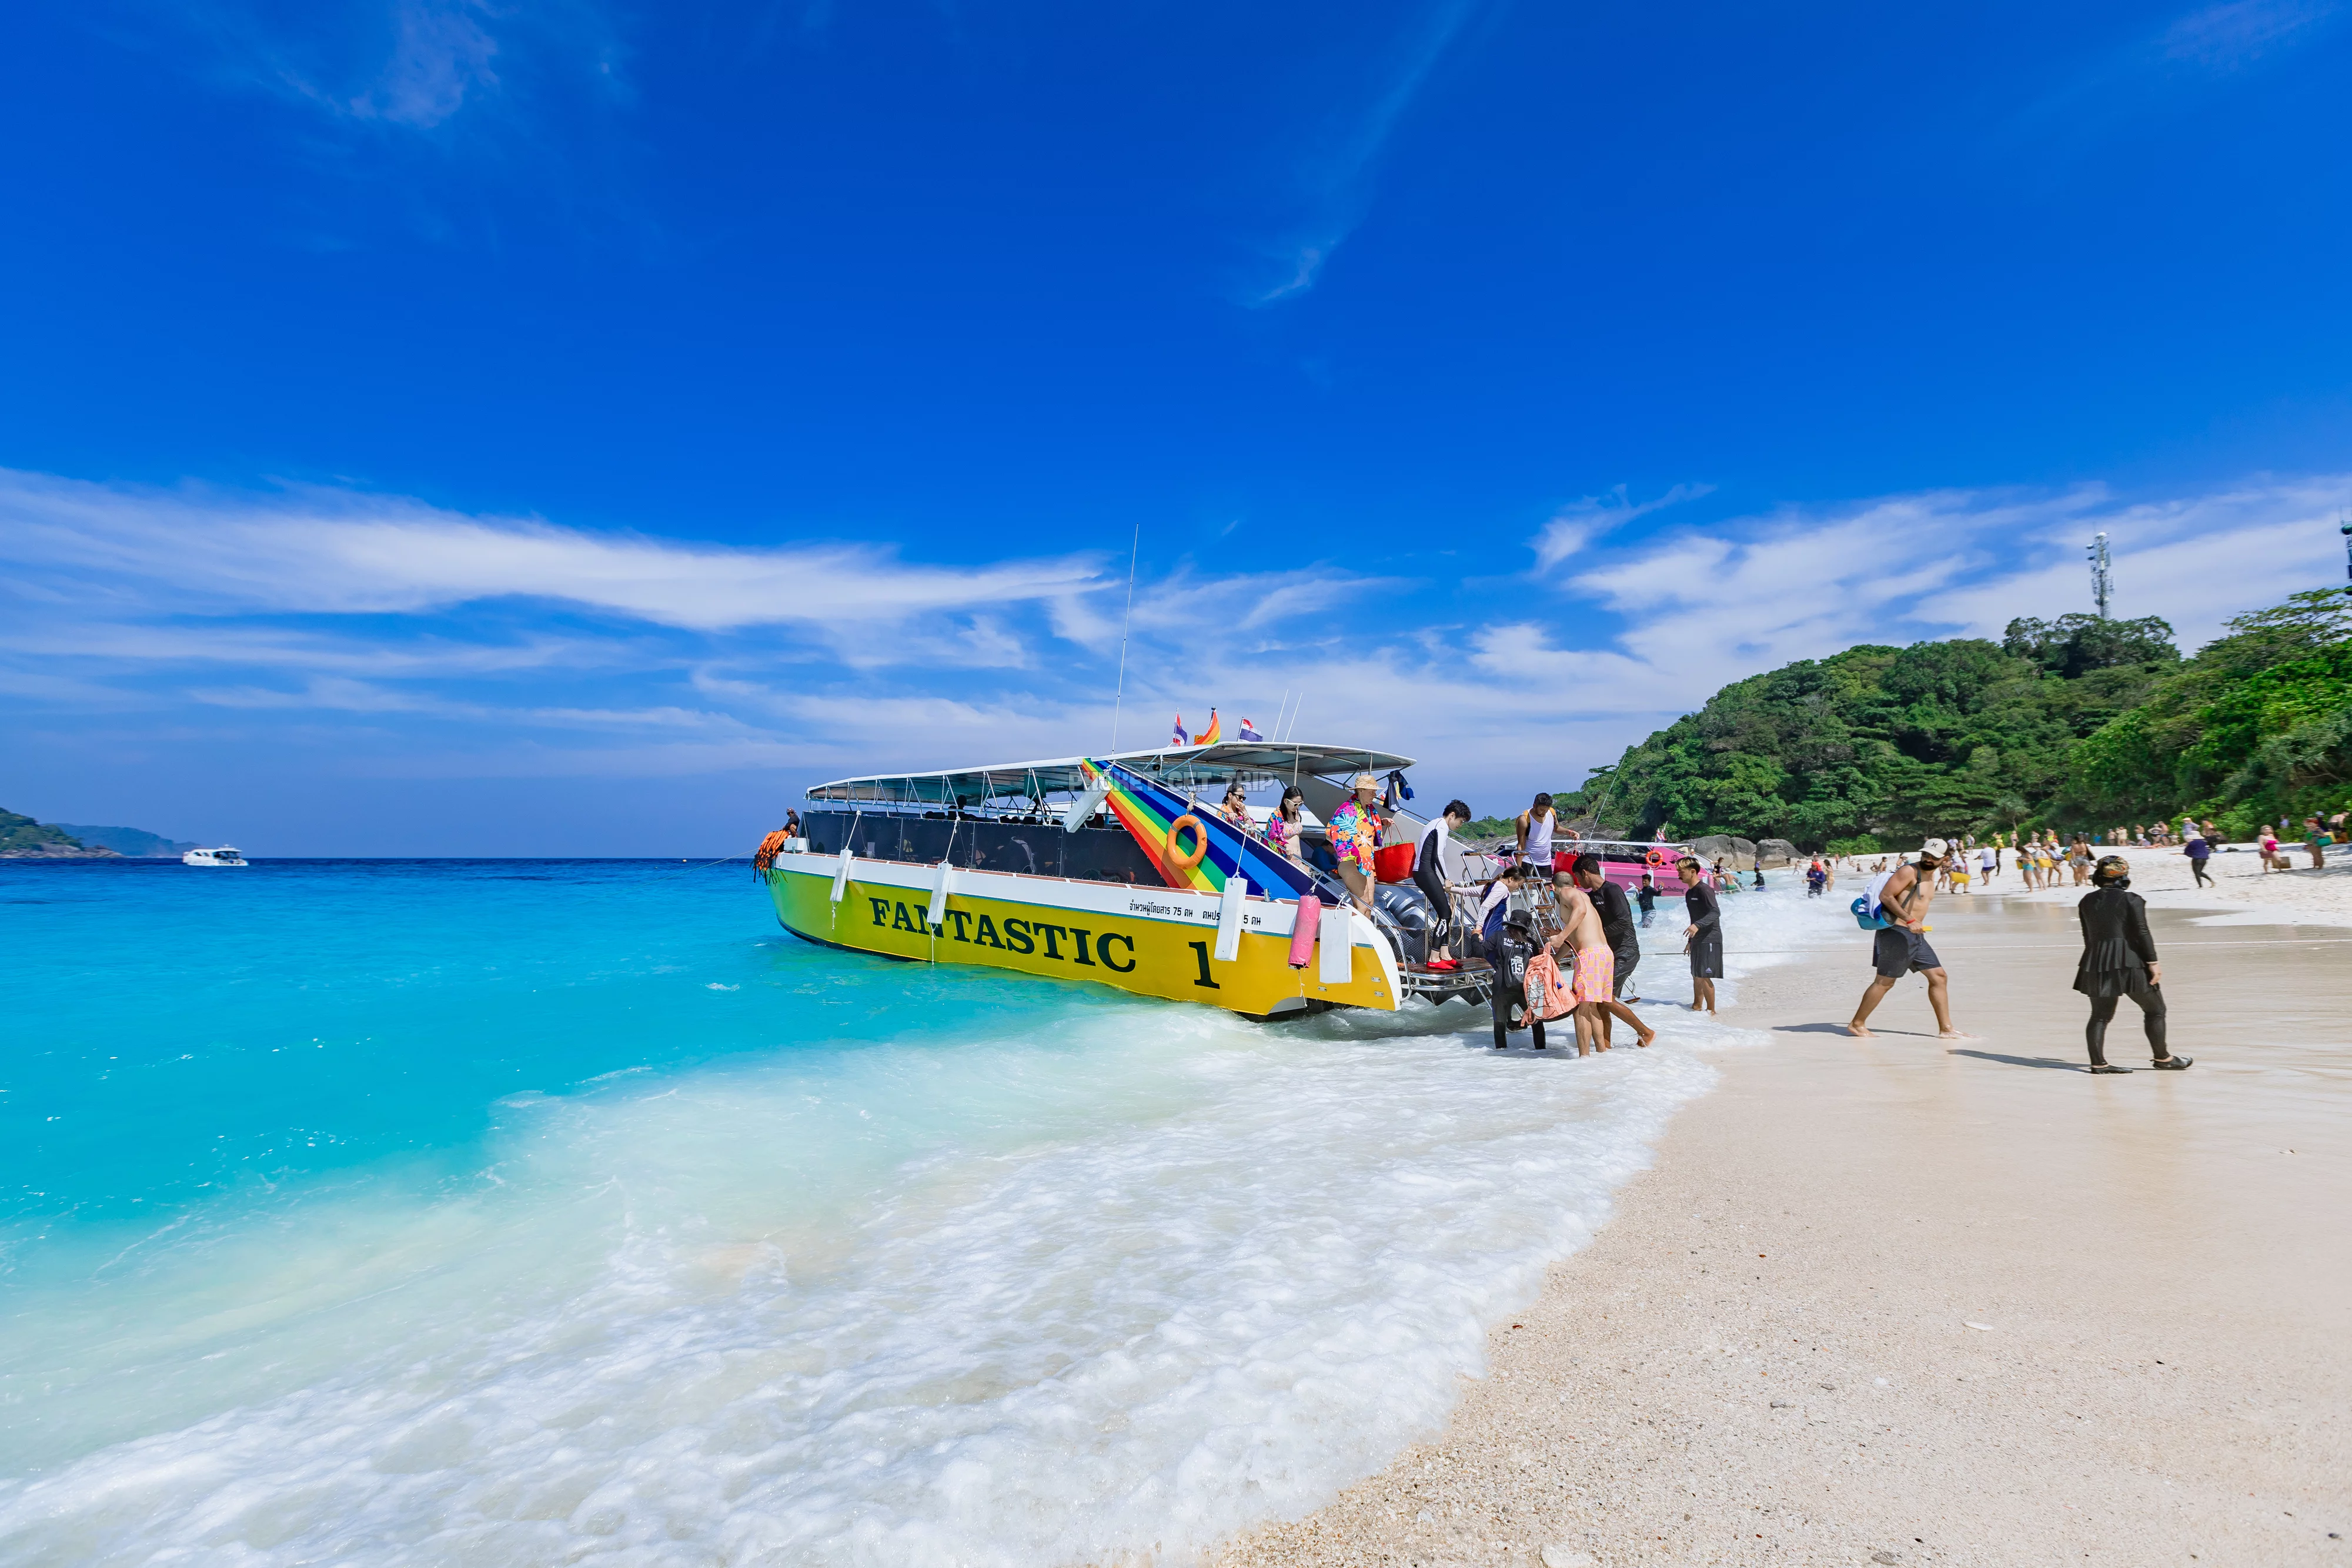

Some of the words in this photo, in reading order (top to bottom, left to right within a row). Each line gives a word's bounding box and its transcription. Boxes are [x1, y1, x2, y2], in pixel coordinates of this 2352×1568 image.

[1130, 899, 1171, 916] จำนวนผู้โดยสาร
[1173, 907, 1182, 916] 75
[1184, 908, 1193, 917] คน
[1251, 916, 1261, 926] คน
[868, 897, 1136, 973] FANTASTIC
[1188, 941, 1220, 989] 1
[1511, 963, 1523, 973] 15
